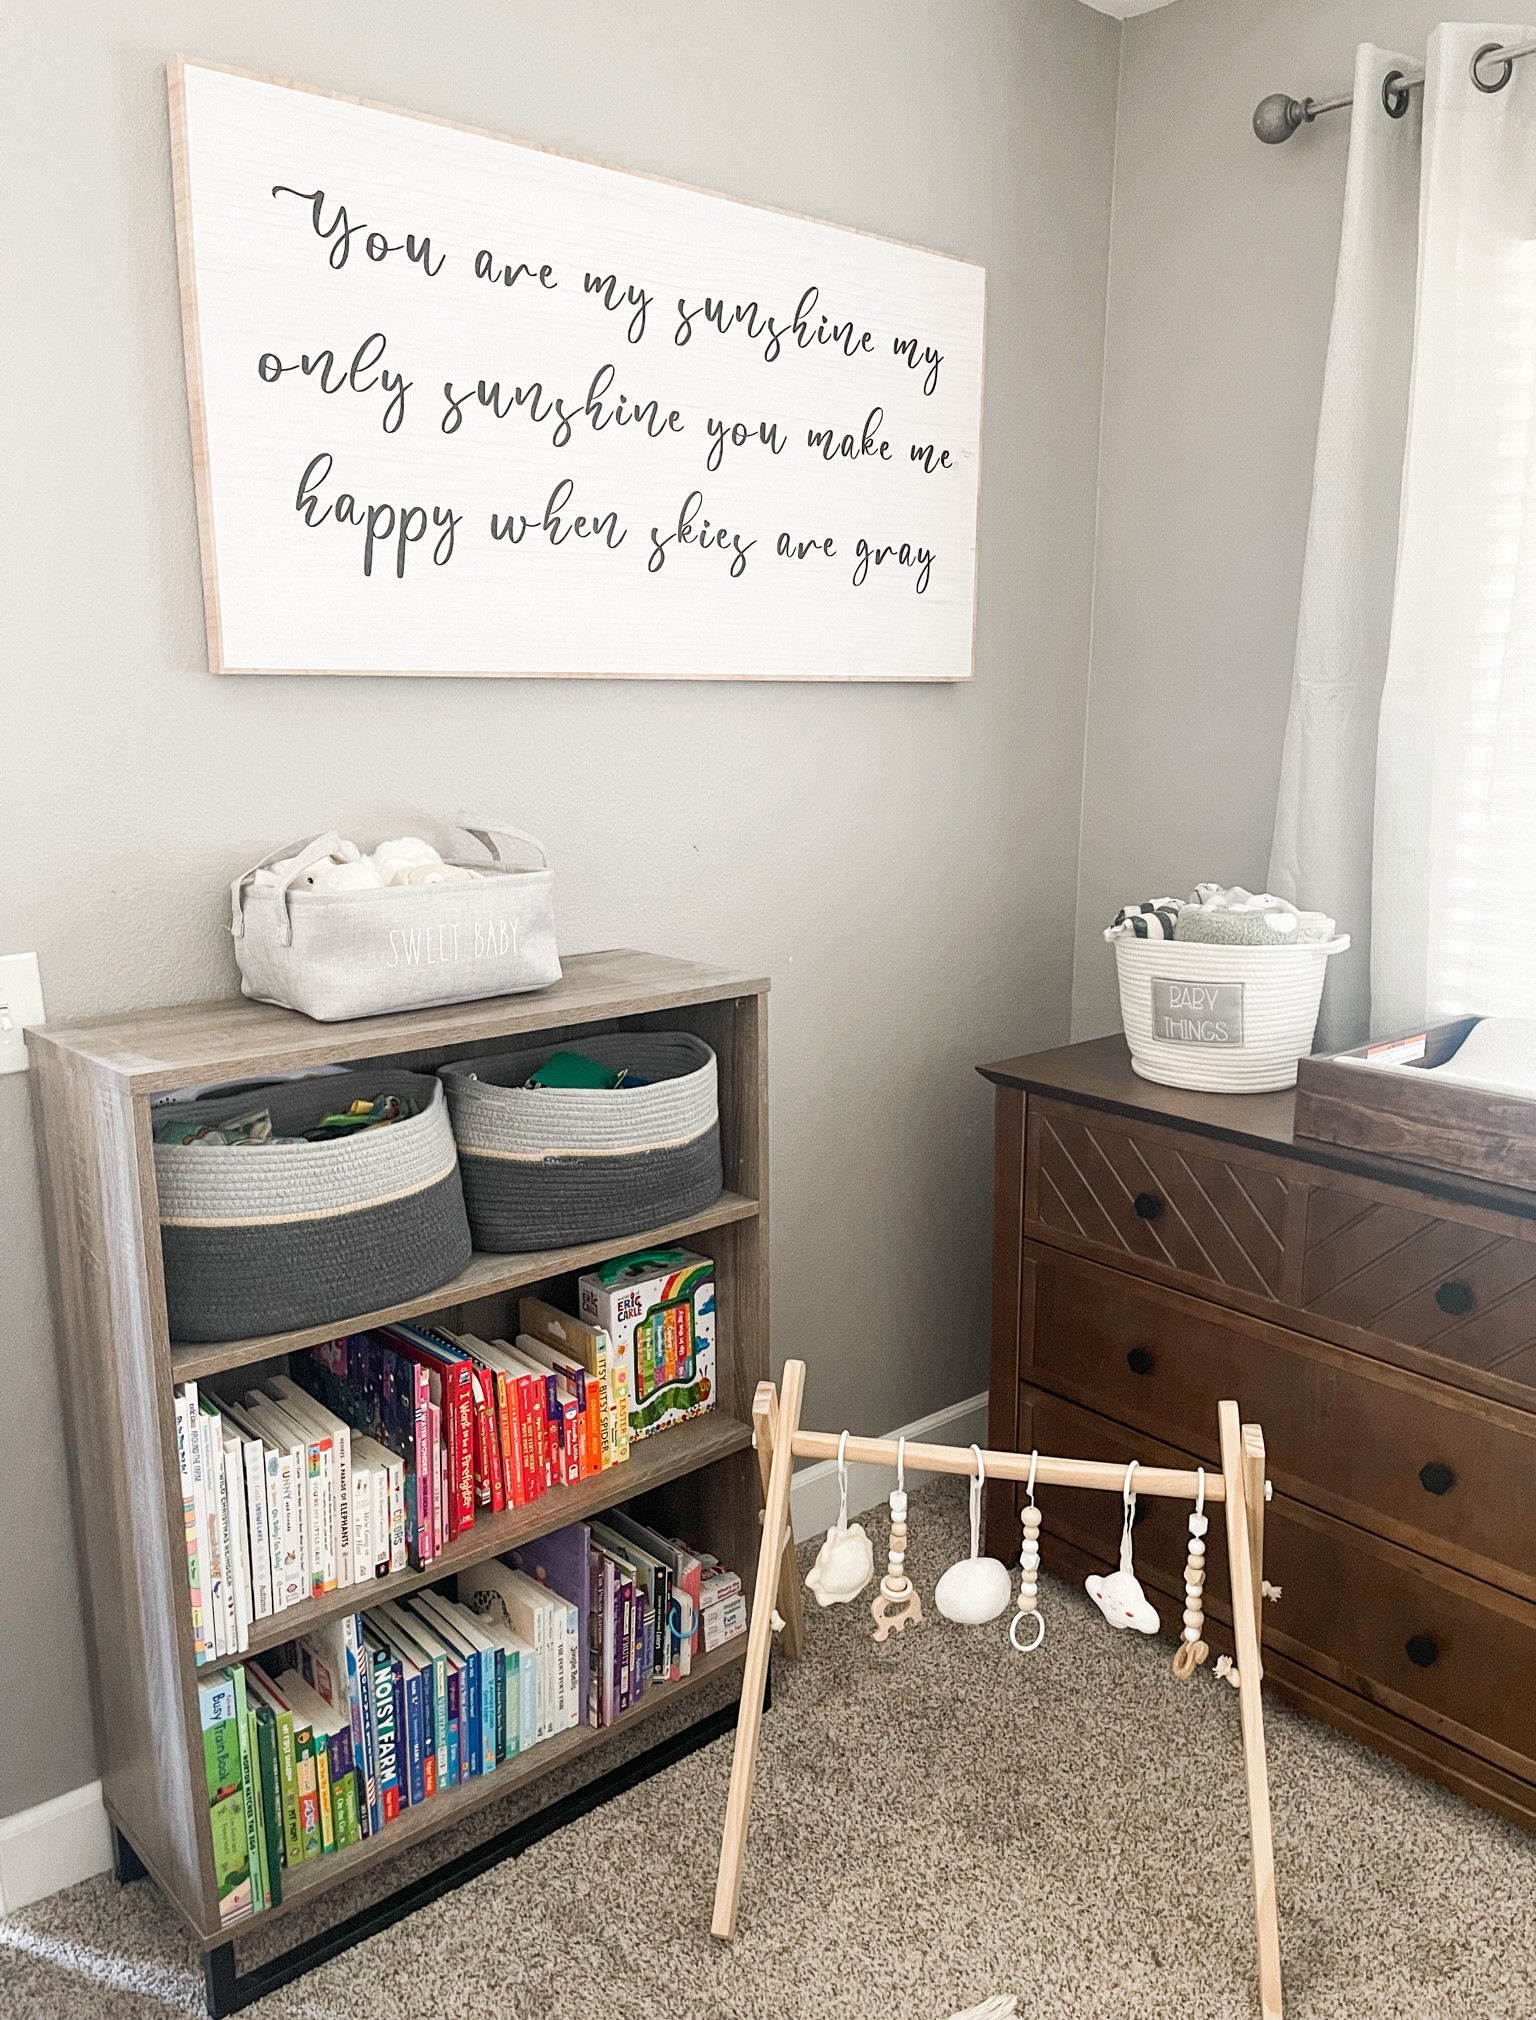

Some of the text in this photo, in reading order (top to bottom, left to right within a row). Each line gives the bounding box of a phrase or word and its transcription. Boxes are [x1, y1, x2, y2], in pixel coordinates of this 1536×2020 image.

[272, 186, 944, 396] You are my sunshine my
[258, 333, 954, 474] only sunshine you make me
[295, 452, 936, 594] happy when skies are gray
[386, 917, 519, 968] SWEET BABY
[1169, 985, 1219, 1011] BABY
[1163, 1015, 1229, 1042] THINGS
[617, 1293, 642, 1312] ERIC
[617, 1306, 643, 1322] CARLE
[679, 1345, 685, 1356] Up
[459, 1391, 470, 1400] I
[598, 1358, 609, 1453] ITSY BITSY SPIDER
[459, 1400, 471, 1430] Want
[590, 1398, 598, 1434] GOODNIGHT
[619, 1398, 627, 1435] EASTER
[462, 1437, 469, 1448] be
[463, 1430, 469, 1438] to
[191, 1430, 202, 1482] AROUND THE FARM
[551, 1442, 559, 1464] Colors
[341, 1492, 347, 1501] OF
[459, 1453, 472, 1509] Firefighter
[220, 1497, 229, 1544] CHRISTMAS
[255, 1503, 263, 1543] SNOWFLAKE
[340, 1502, 349, 1548] ELEPHANTS
[392, 1509, 403, 1546] COLORS
[224, 1545, 232, 1587] REINDEER
[723, 1614, 736, 1625] Fun
[621, 1635, 629, 1665] FRUIT
[570, 1646, 578, 1690] Jingle Bells
[209, 1692, 230, 1782] Busy Train Book
[374, 1666, 396, 1784] NOISY FARM
[438, 1697, 446, 1746] VEGETABLE
[243, 1755, 251, 1785] HORTON
[245, 1787, 254, 1818] HATCHES
[288, 1809, 296, 1821] MY
[337, 1798, 344, 1810] On
[339, 1821, 346, 1833] Go
